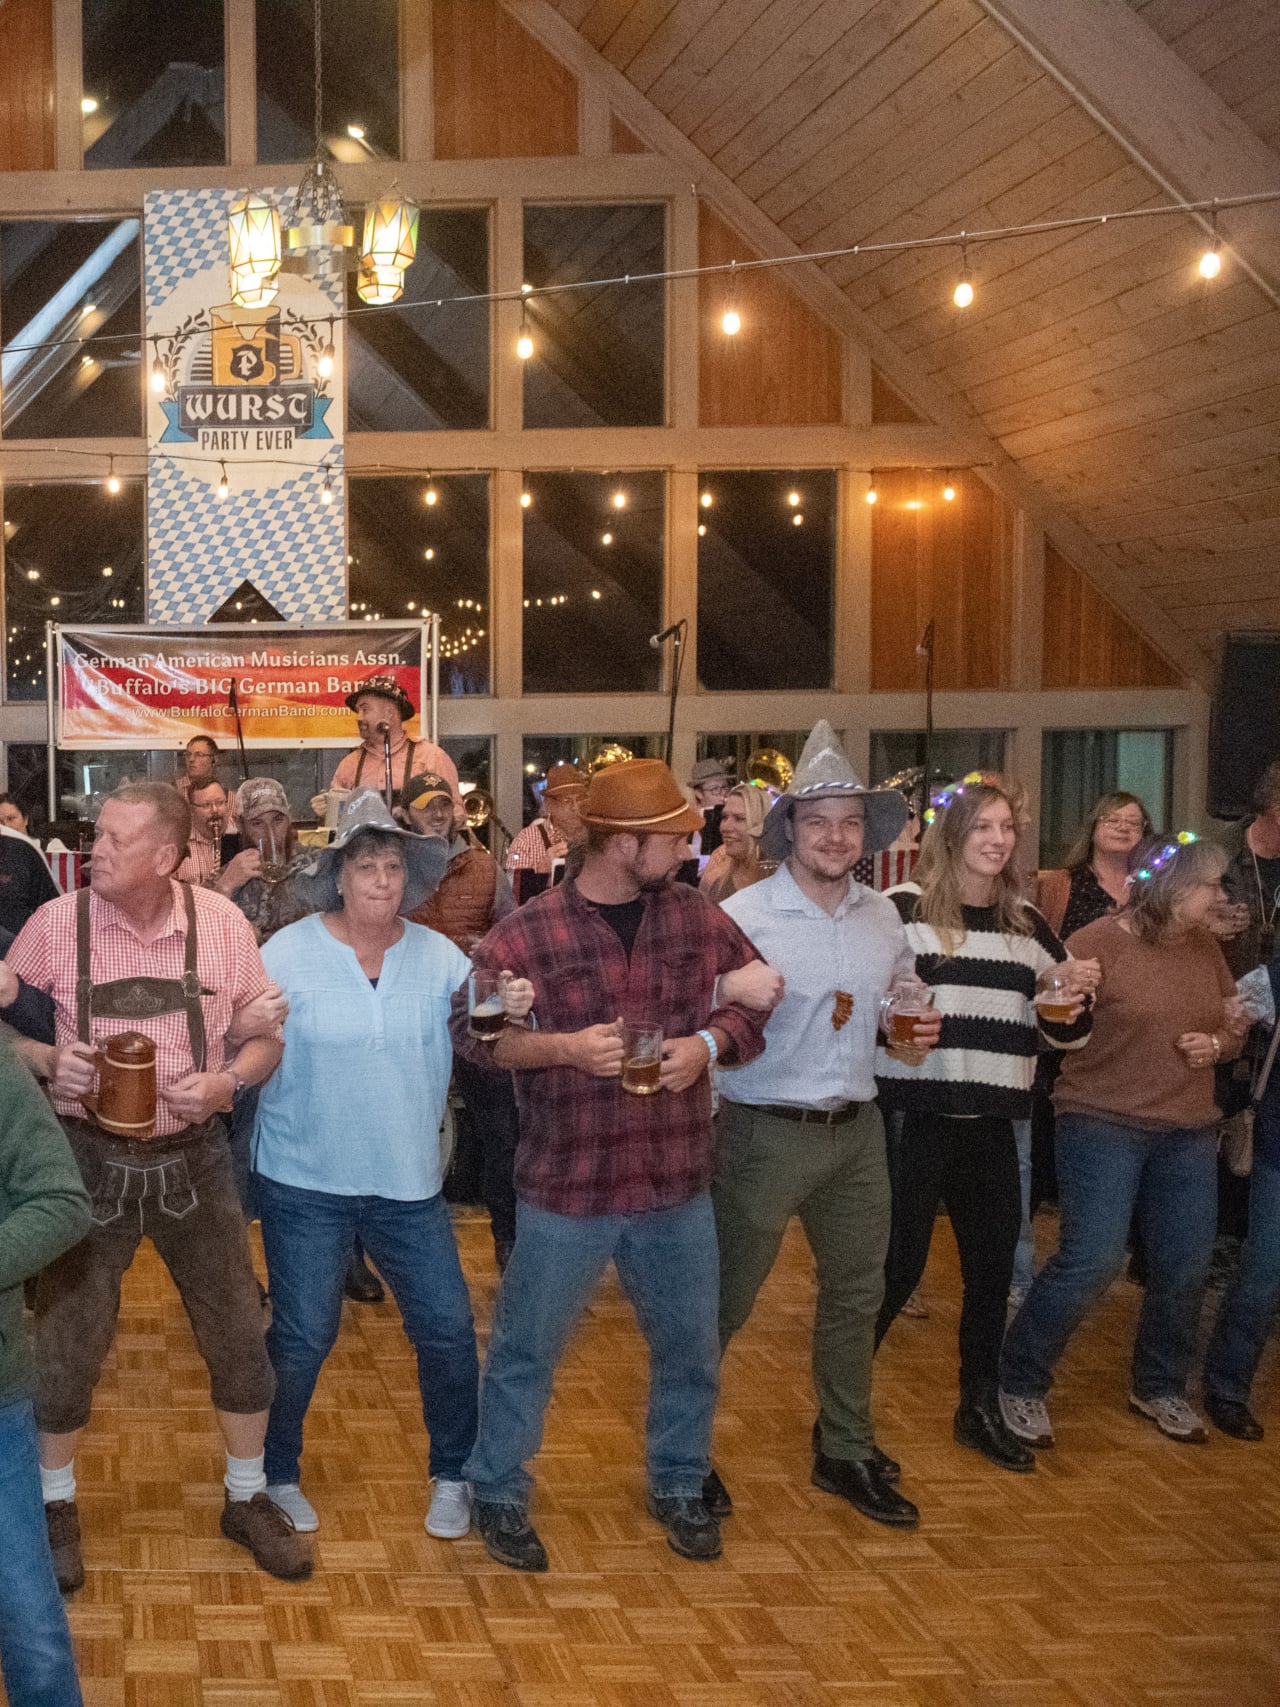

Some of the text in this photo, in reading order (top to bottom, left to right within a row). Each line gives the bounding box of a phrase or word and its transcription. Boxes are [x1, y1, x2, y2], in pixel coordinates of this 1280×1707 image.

[185, 392, 308, 421] WURST
[201, 429, 293, 450] PARTY EVER
[75, 649, 407, 669] German American Musicians Assn.
[196, 677, 232, 695] BIG
[239, 677, 321, 694] German
